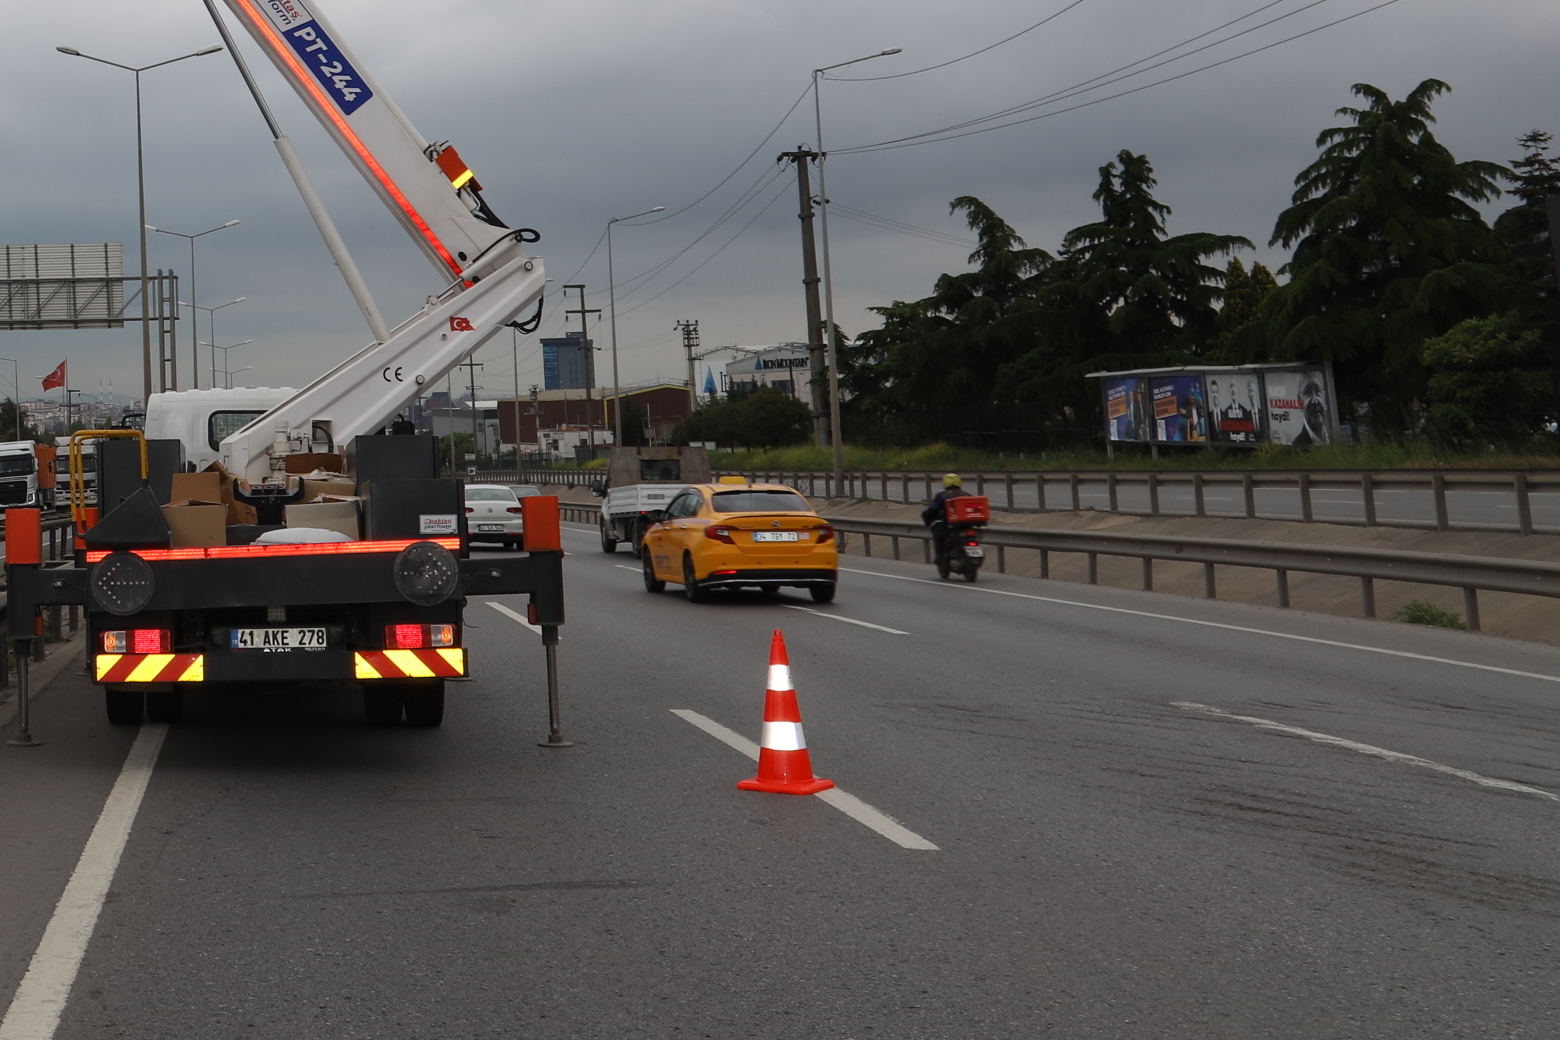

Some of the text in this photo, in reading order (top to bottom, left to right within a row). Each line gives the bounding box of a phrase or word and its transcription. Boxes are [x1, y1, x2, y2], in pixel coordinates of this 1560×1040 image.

[293, 26, 362, 103] PT-244
[239, 629, 325, 646] 41 AKE 278
